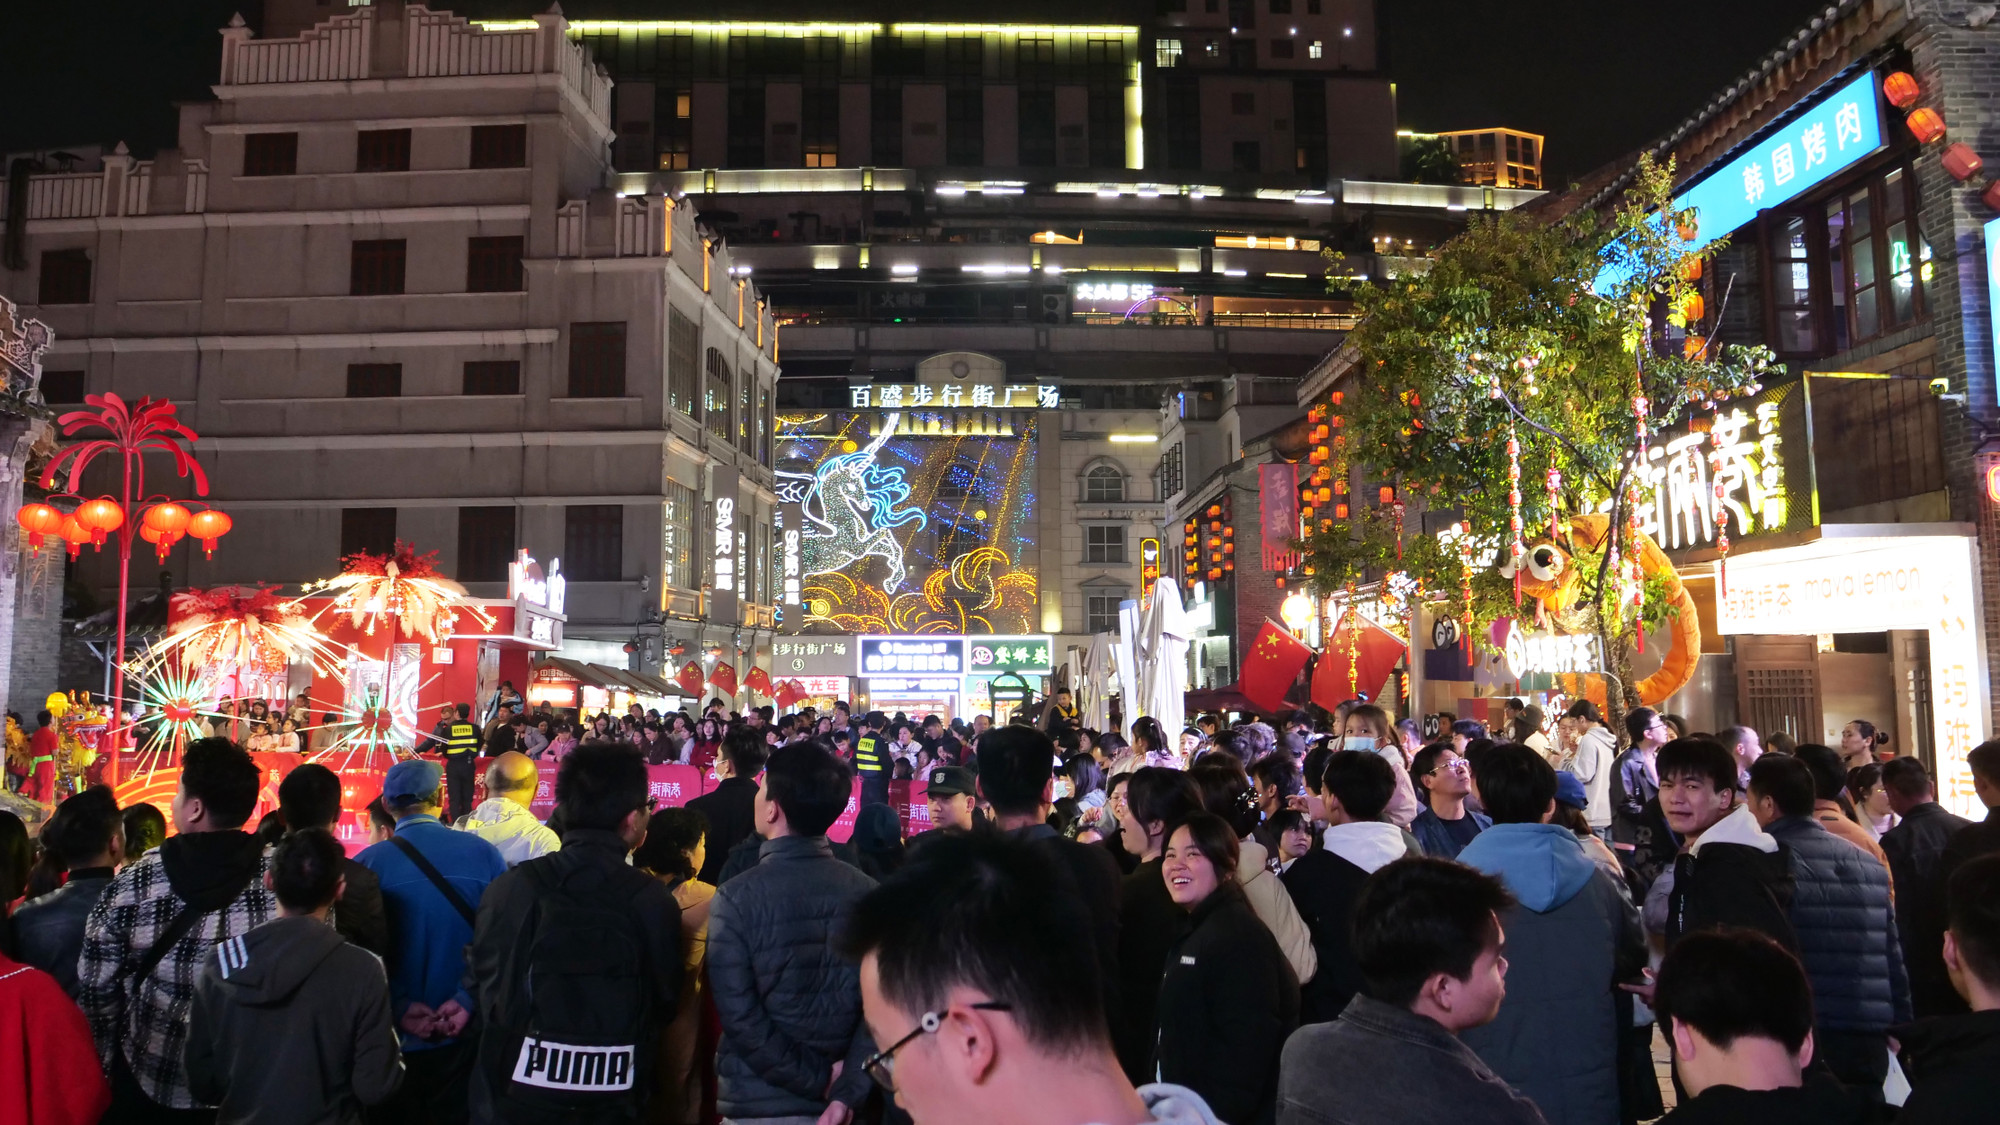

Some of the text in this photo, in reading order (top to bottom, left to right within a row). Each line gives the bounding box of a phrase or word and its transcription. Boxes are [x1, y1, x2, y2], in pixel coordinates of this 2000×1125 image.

[1742, 102, 1862, 204] 韩国烤肉
[1131, 284, 1153, 301] 5F
[849, 384, 1060, 408] 百盛步行街广场
[800, 679, 840, 691] 光年
[524, 1044, 630, 1086] PUMA
